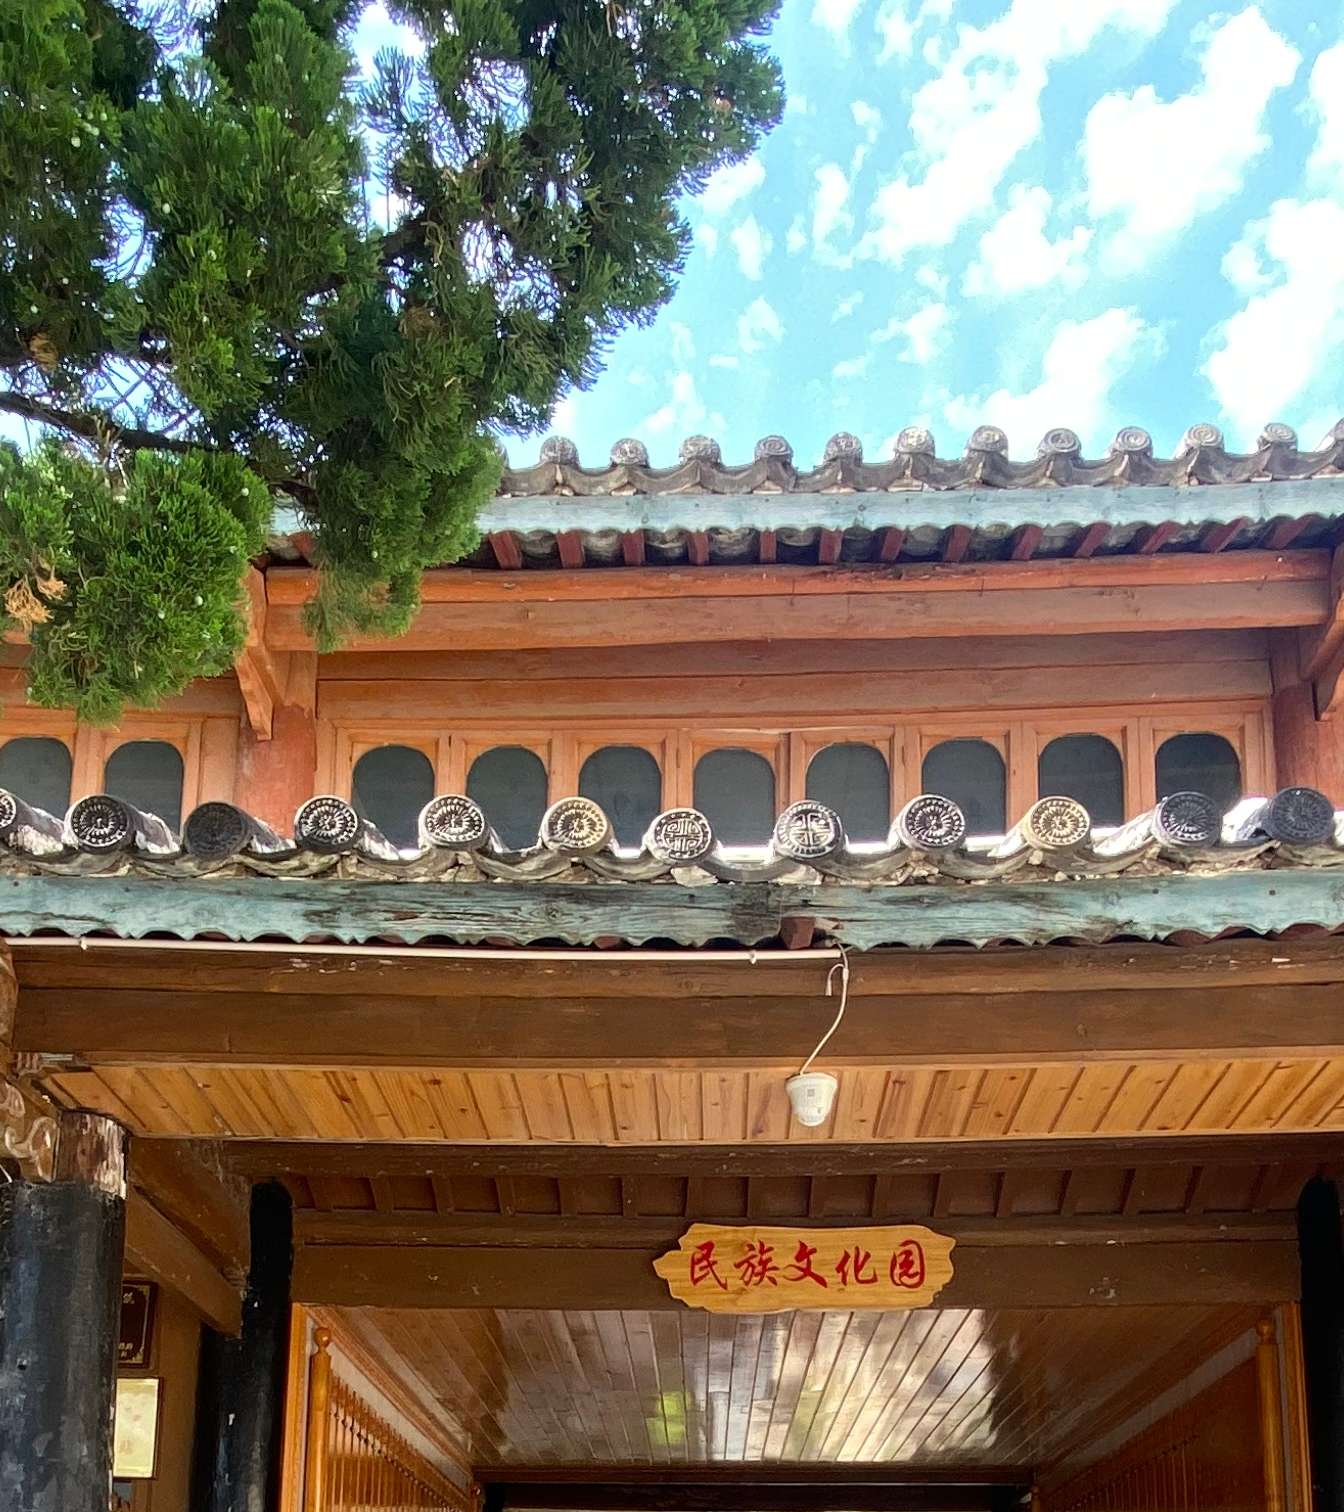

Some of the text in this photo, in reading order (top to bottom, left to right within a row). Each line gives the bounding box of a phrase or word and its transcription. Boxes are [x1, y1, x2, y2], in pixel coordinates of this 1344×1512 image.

[689, 1239, 926, 1290] 民族文化园
